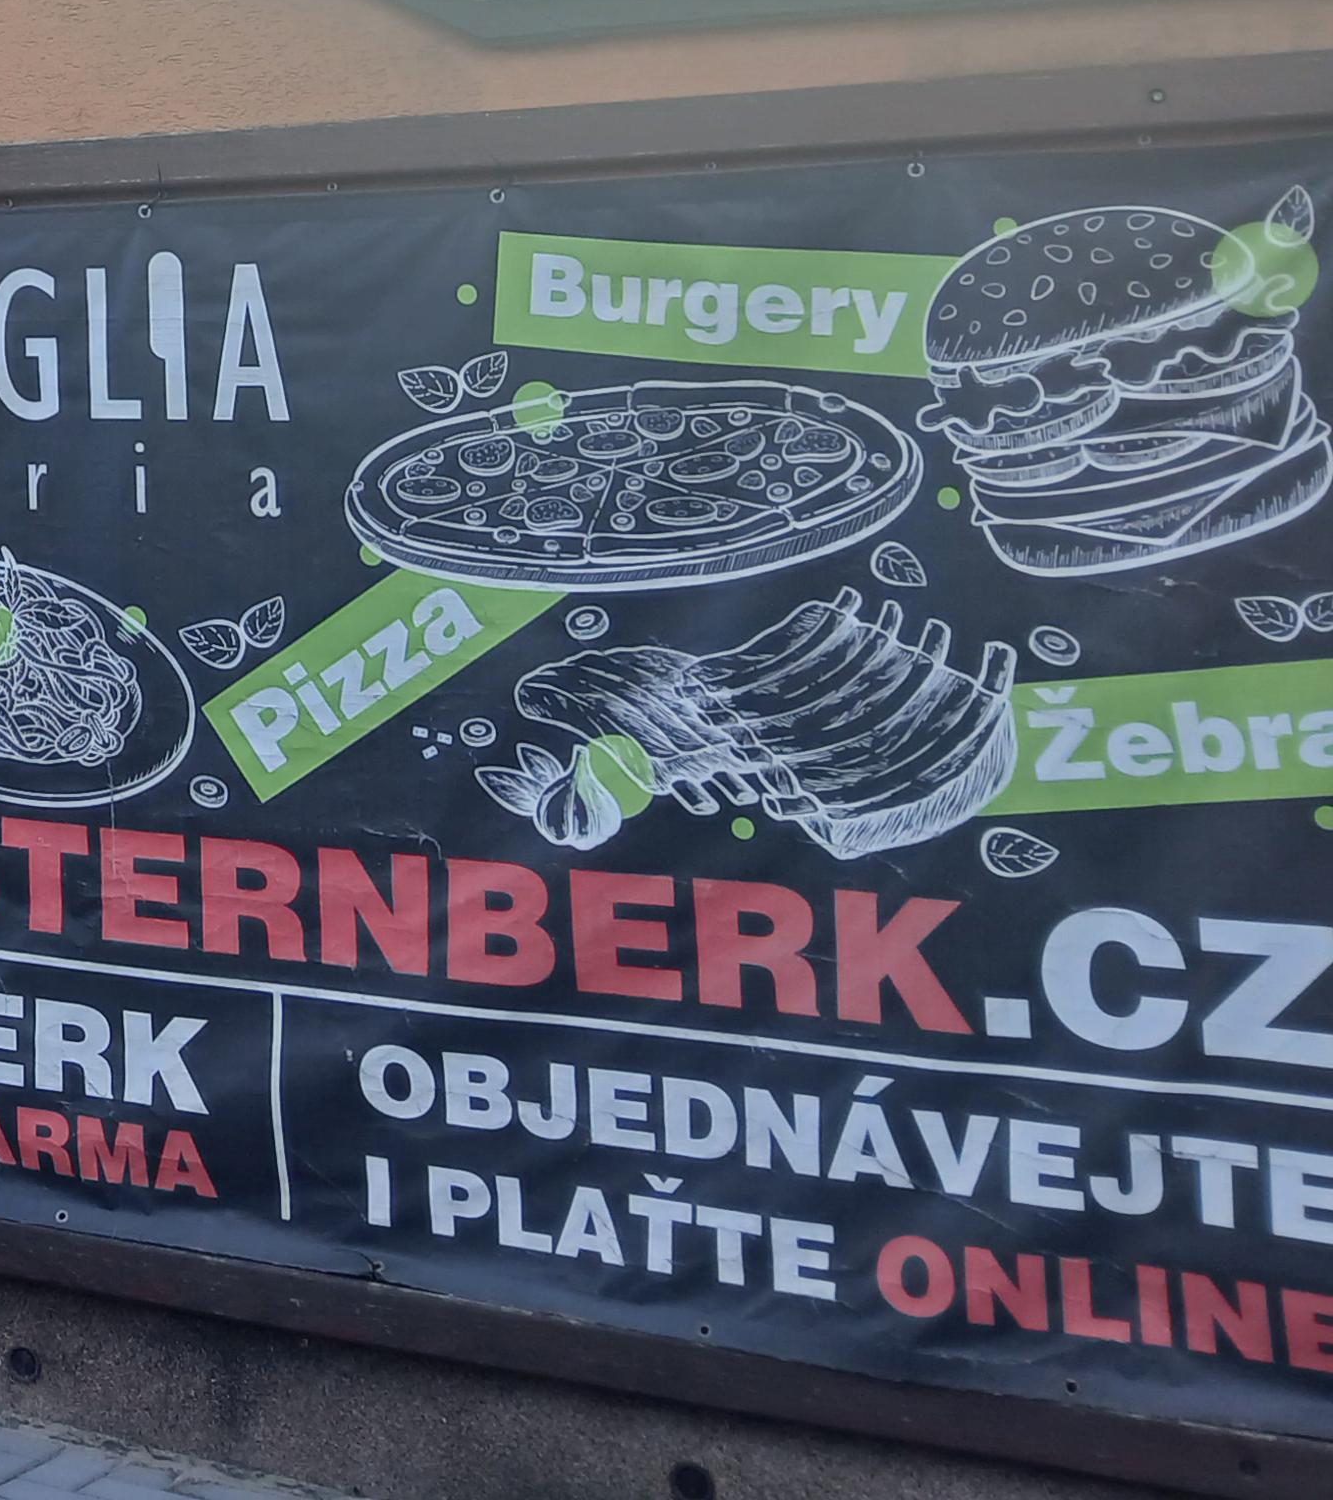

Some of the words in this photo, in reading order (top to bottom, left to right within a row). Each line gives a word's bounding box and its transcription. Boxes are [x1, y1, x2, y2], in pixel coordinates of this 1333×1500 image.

[530, 252, 908, 353] Burgery
[233, 587, 483, 773] Pizza
[358, 1045, 1333, 1244] OBJEDNÁVEJTE
[364, 1156, 391, 1227] I
[427, 1165, 837, 1300] PLAŤTE
[876, 1236, 1333, 1372] ONLINE
